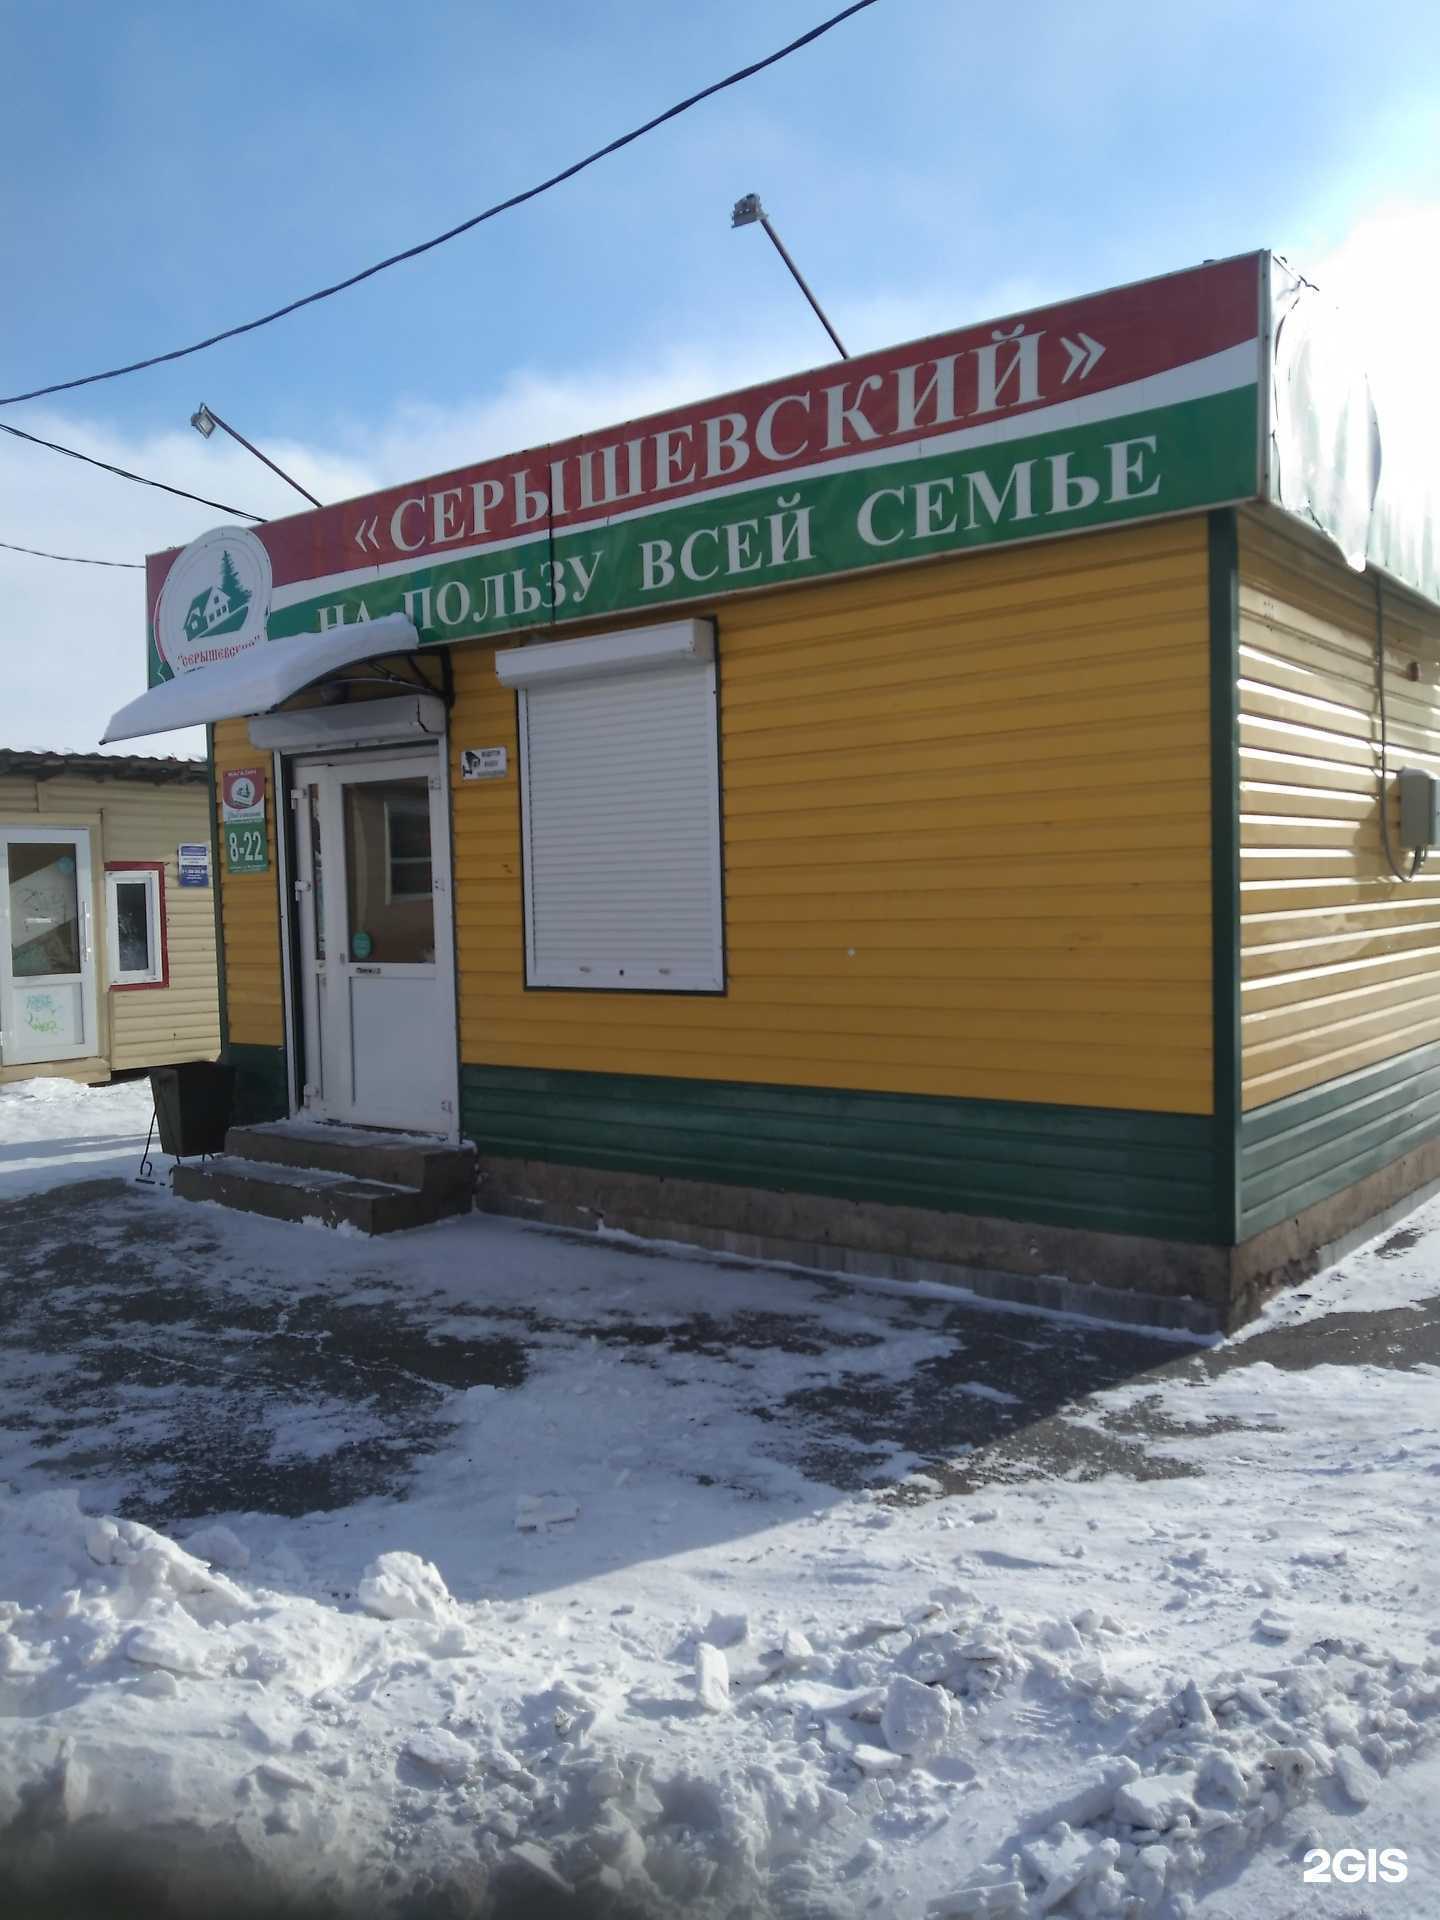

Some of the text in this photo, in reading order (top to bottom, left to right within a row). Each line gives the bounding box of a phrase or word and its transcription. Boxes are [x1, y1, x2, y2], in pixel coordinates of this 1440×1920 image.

[354, 323, 1106, 553] «СЕРЫШЕВСКИЙ»
[402, 550, 605, 630] ПОЛЬЗУ
[639, 492, 817, 591] ВСЕЙ
[856, 435, 1161, 547] СЕМЬЕ
[229, 831, 263, 862] 8-22
